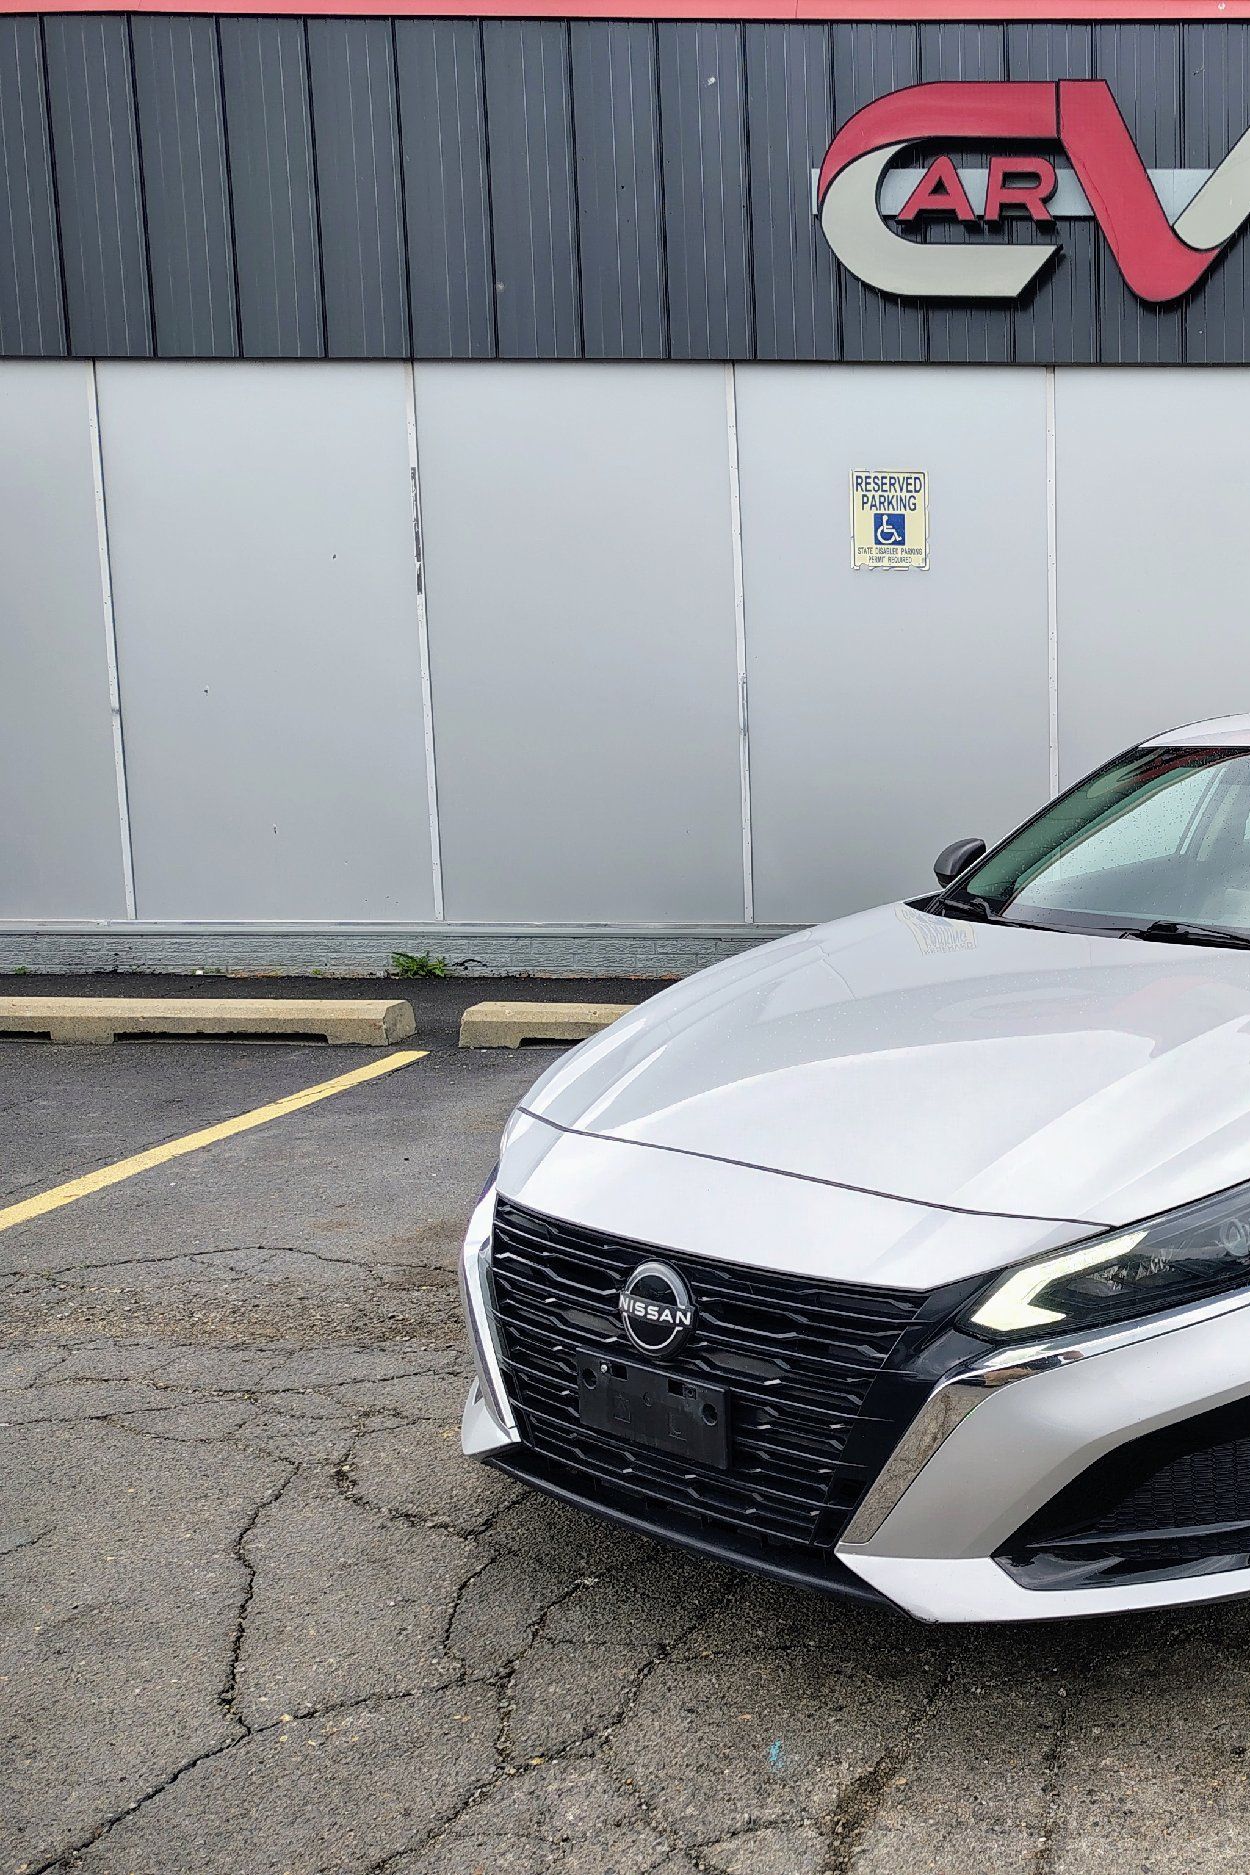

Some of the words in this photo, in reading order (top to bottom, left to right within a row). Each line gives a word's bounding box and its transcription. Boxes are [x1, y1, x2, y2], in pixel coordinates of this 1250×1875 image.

[855, 475, 922, 493] RESERVED
[861, 494, 917, 511] PARKING
[857, 547, 873, 555] STATE
[901, 548, 923, 556] PARKING
[887, 556, 912, 564] REQUIRED
[619, 1295, 692, 1325] NISSAN
